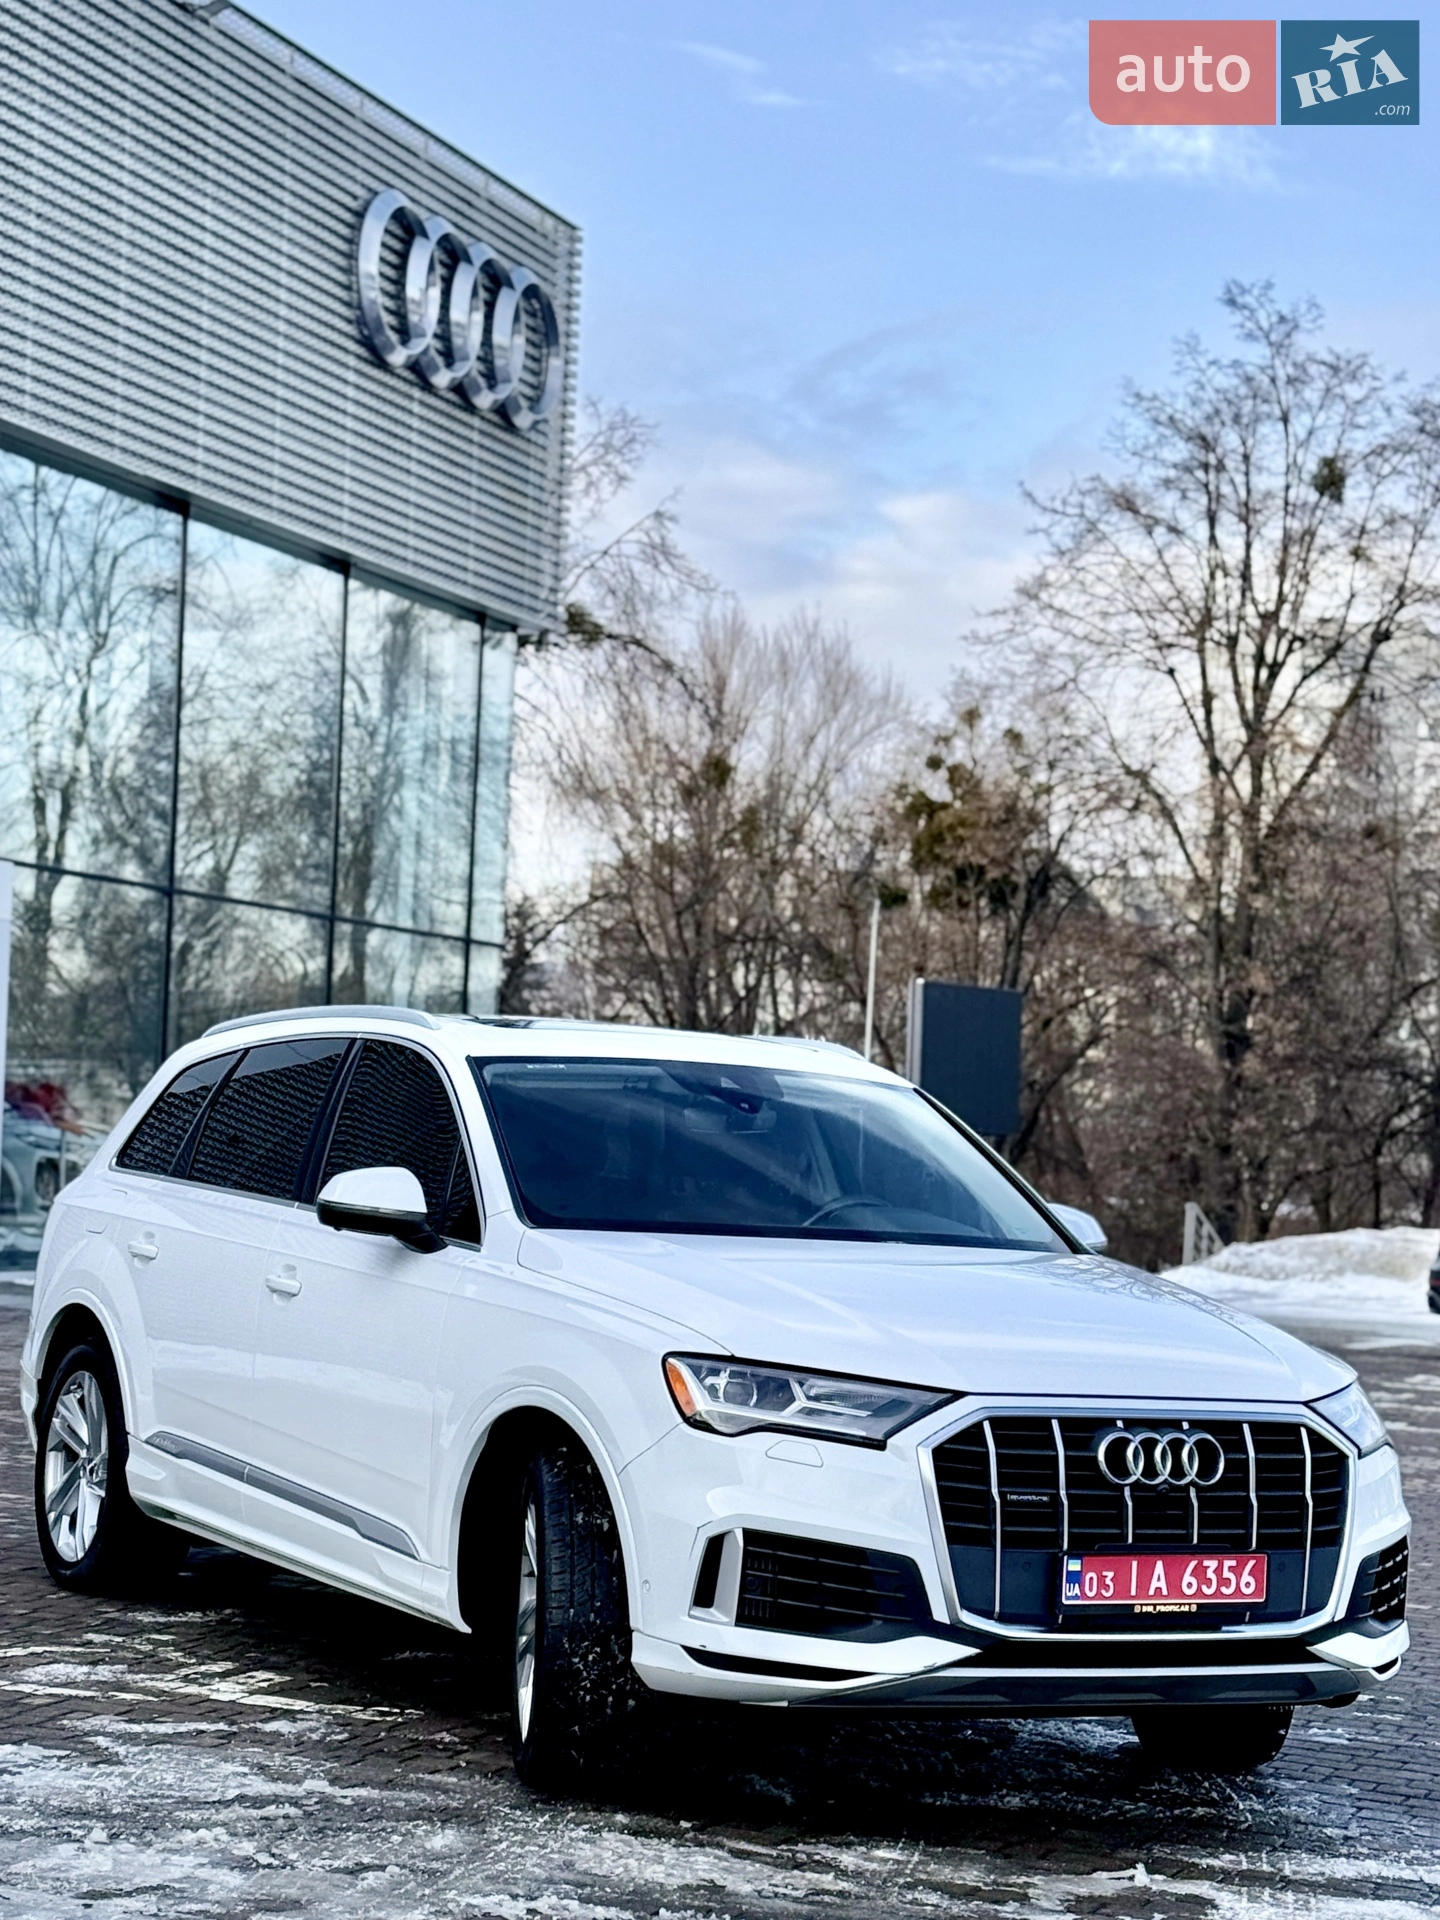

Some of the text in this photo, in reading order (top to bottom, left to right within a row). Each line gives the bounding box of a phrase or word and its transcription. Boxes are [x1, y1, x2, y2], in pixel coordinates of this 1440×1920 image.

[1066, 1583, 1081, 1597] UA
[1084, 1571, 1115, 1597] 03
[1181, 1559, 1257, 1596] 6356
